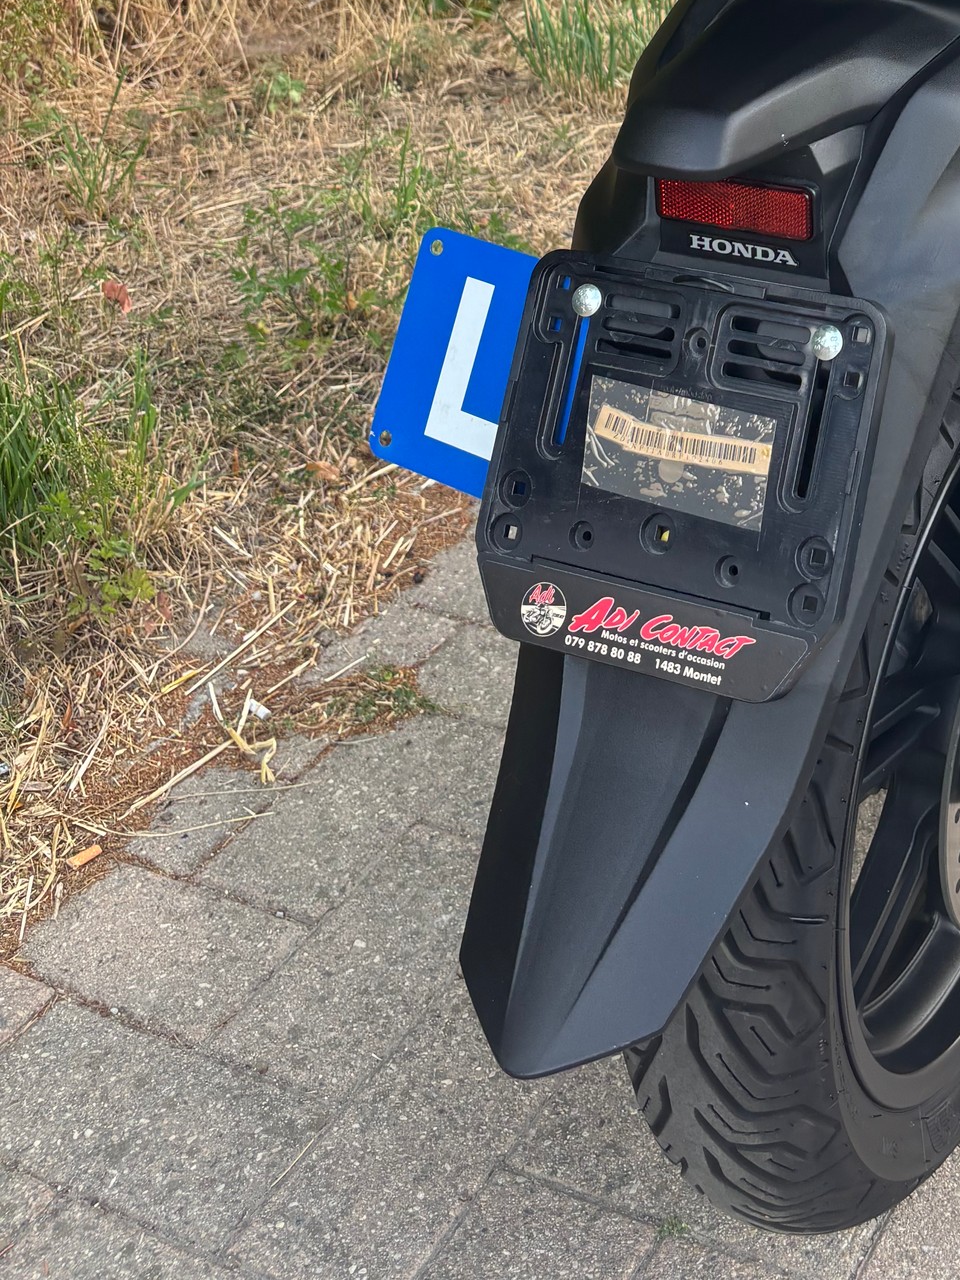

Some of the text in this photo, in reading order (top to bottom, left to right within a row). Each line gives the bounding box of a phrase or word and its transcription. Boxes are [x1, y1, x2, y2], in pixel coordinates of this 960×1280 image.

[689, 234, 798, 267] HONDA
[424, 276, 499, 461] L
[528, 583, 556, 605] Adi
[568, 596, 756, 660] ADI CONTACT
[601, 629, 726, 671] Motos et scooters d'occasion
[564, 634, 722, 687] 079 878 80 88 1483 Montet
